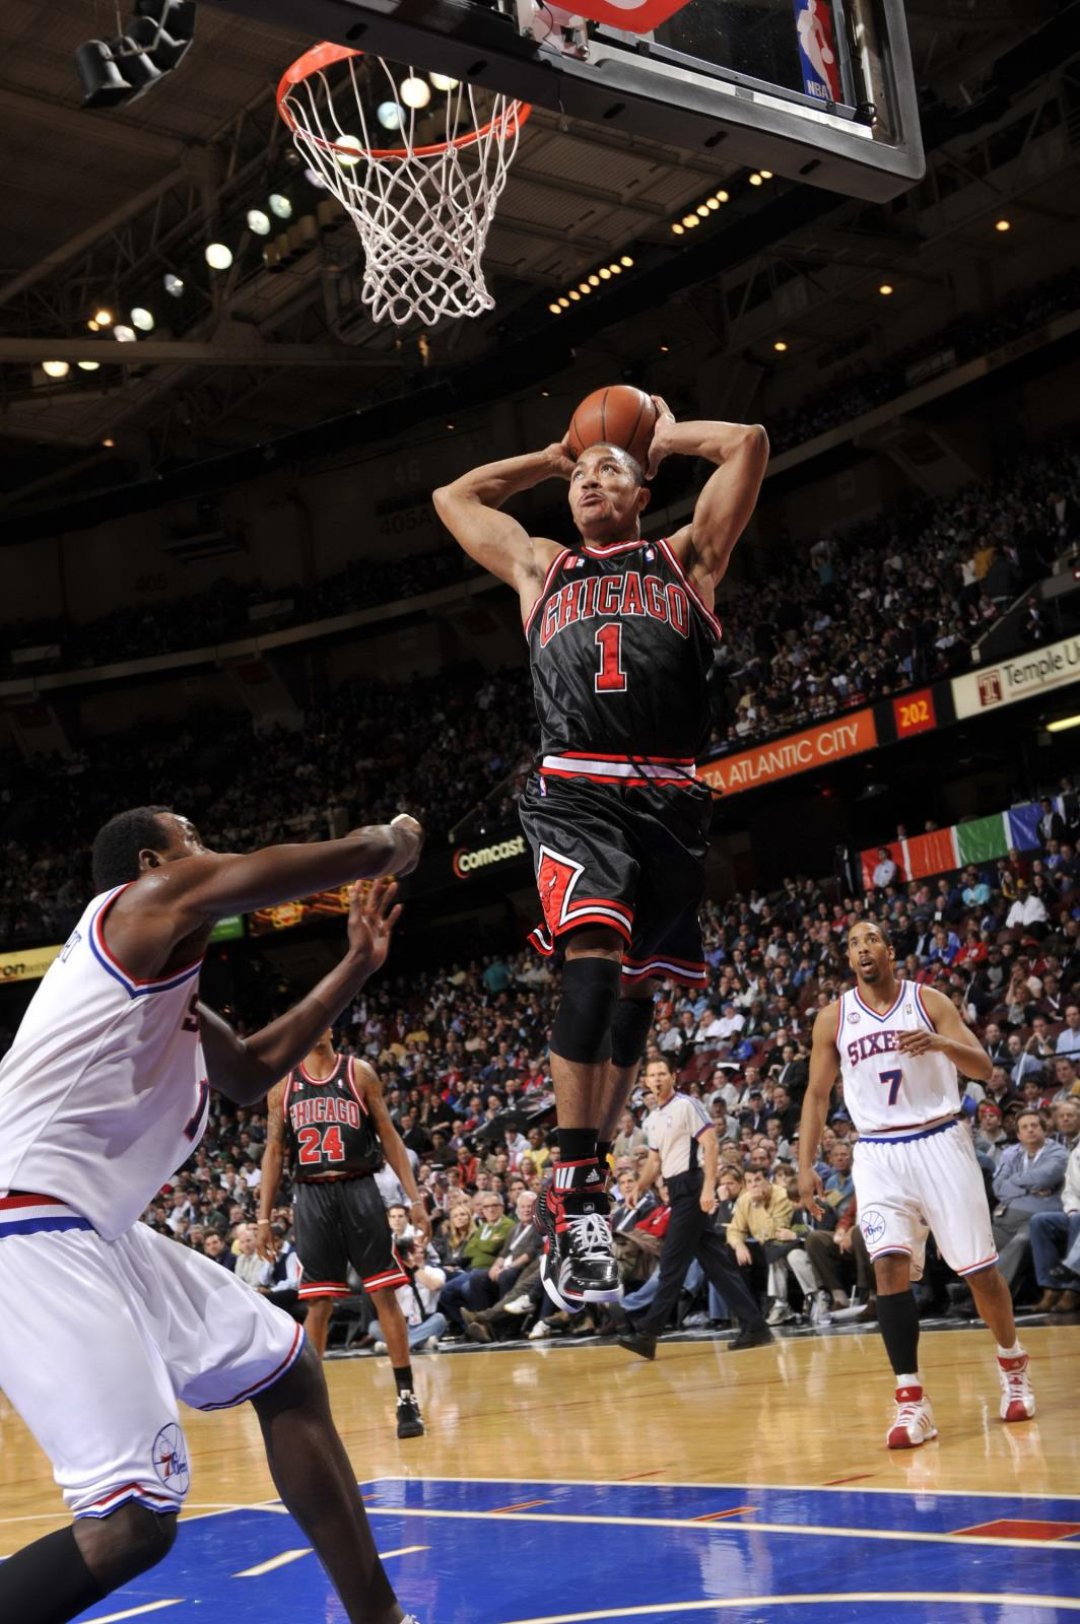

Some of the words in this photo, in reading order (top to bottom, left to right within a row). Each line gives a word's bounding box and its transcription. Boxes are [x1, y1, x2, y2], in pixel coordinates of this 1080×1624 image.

[806, 79, 829, 100] NBA
[540, 571, 690, 648] CHICAGO
[594, 622, 627, 693] 1
[1003, 650, 1064, 687] Temple
[1064, 640, 1080, 665] U
[899, 700, 929, 727] 202
[702, 769, 727, 790] TA
[728, 739, 813, 787] ATLANTIC
[816, 722, 859, 756] CITY
[458, 835, 526, 872] comcast
[0, 963, 26, 977] on
[847, 1029, 908, 1067] SIXE
[879, 1068, 903, 1106] 7
[289, 1096, 360, 1132] CHICAGO
[297, 1125, 345, 1165] 24
